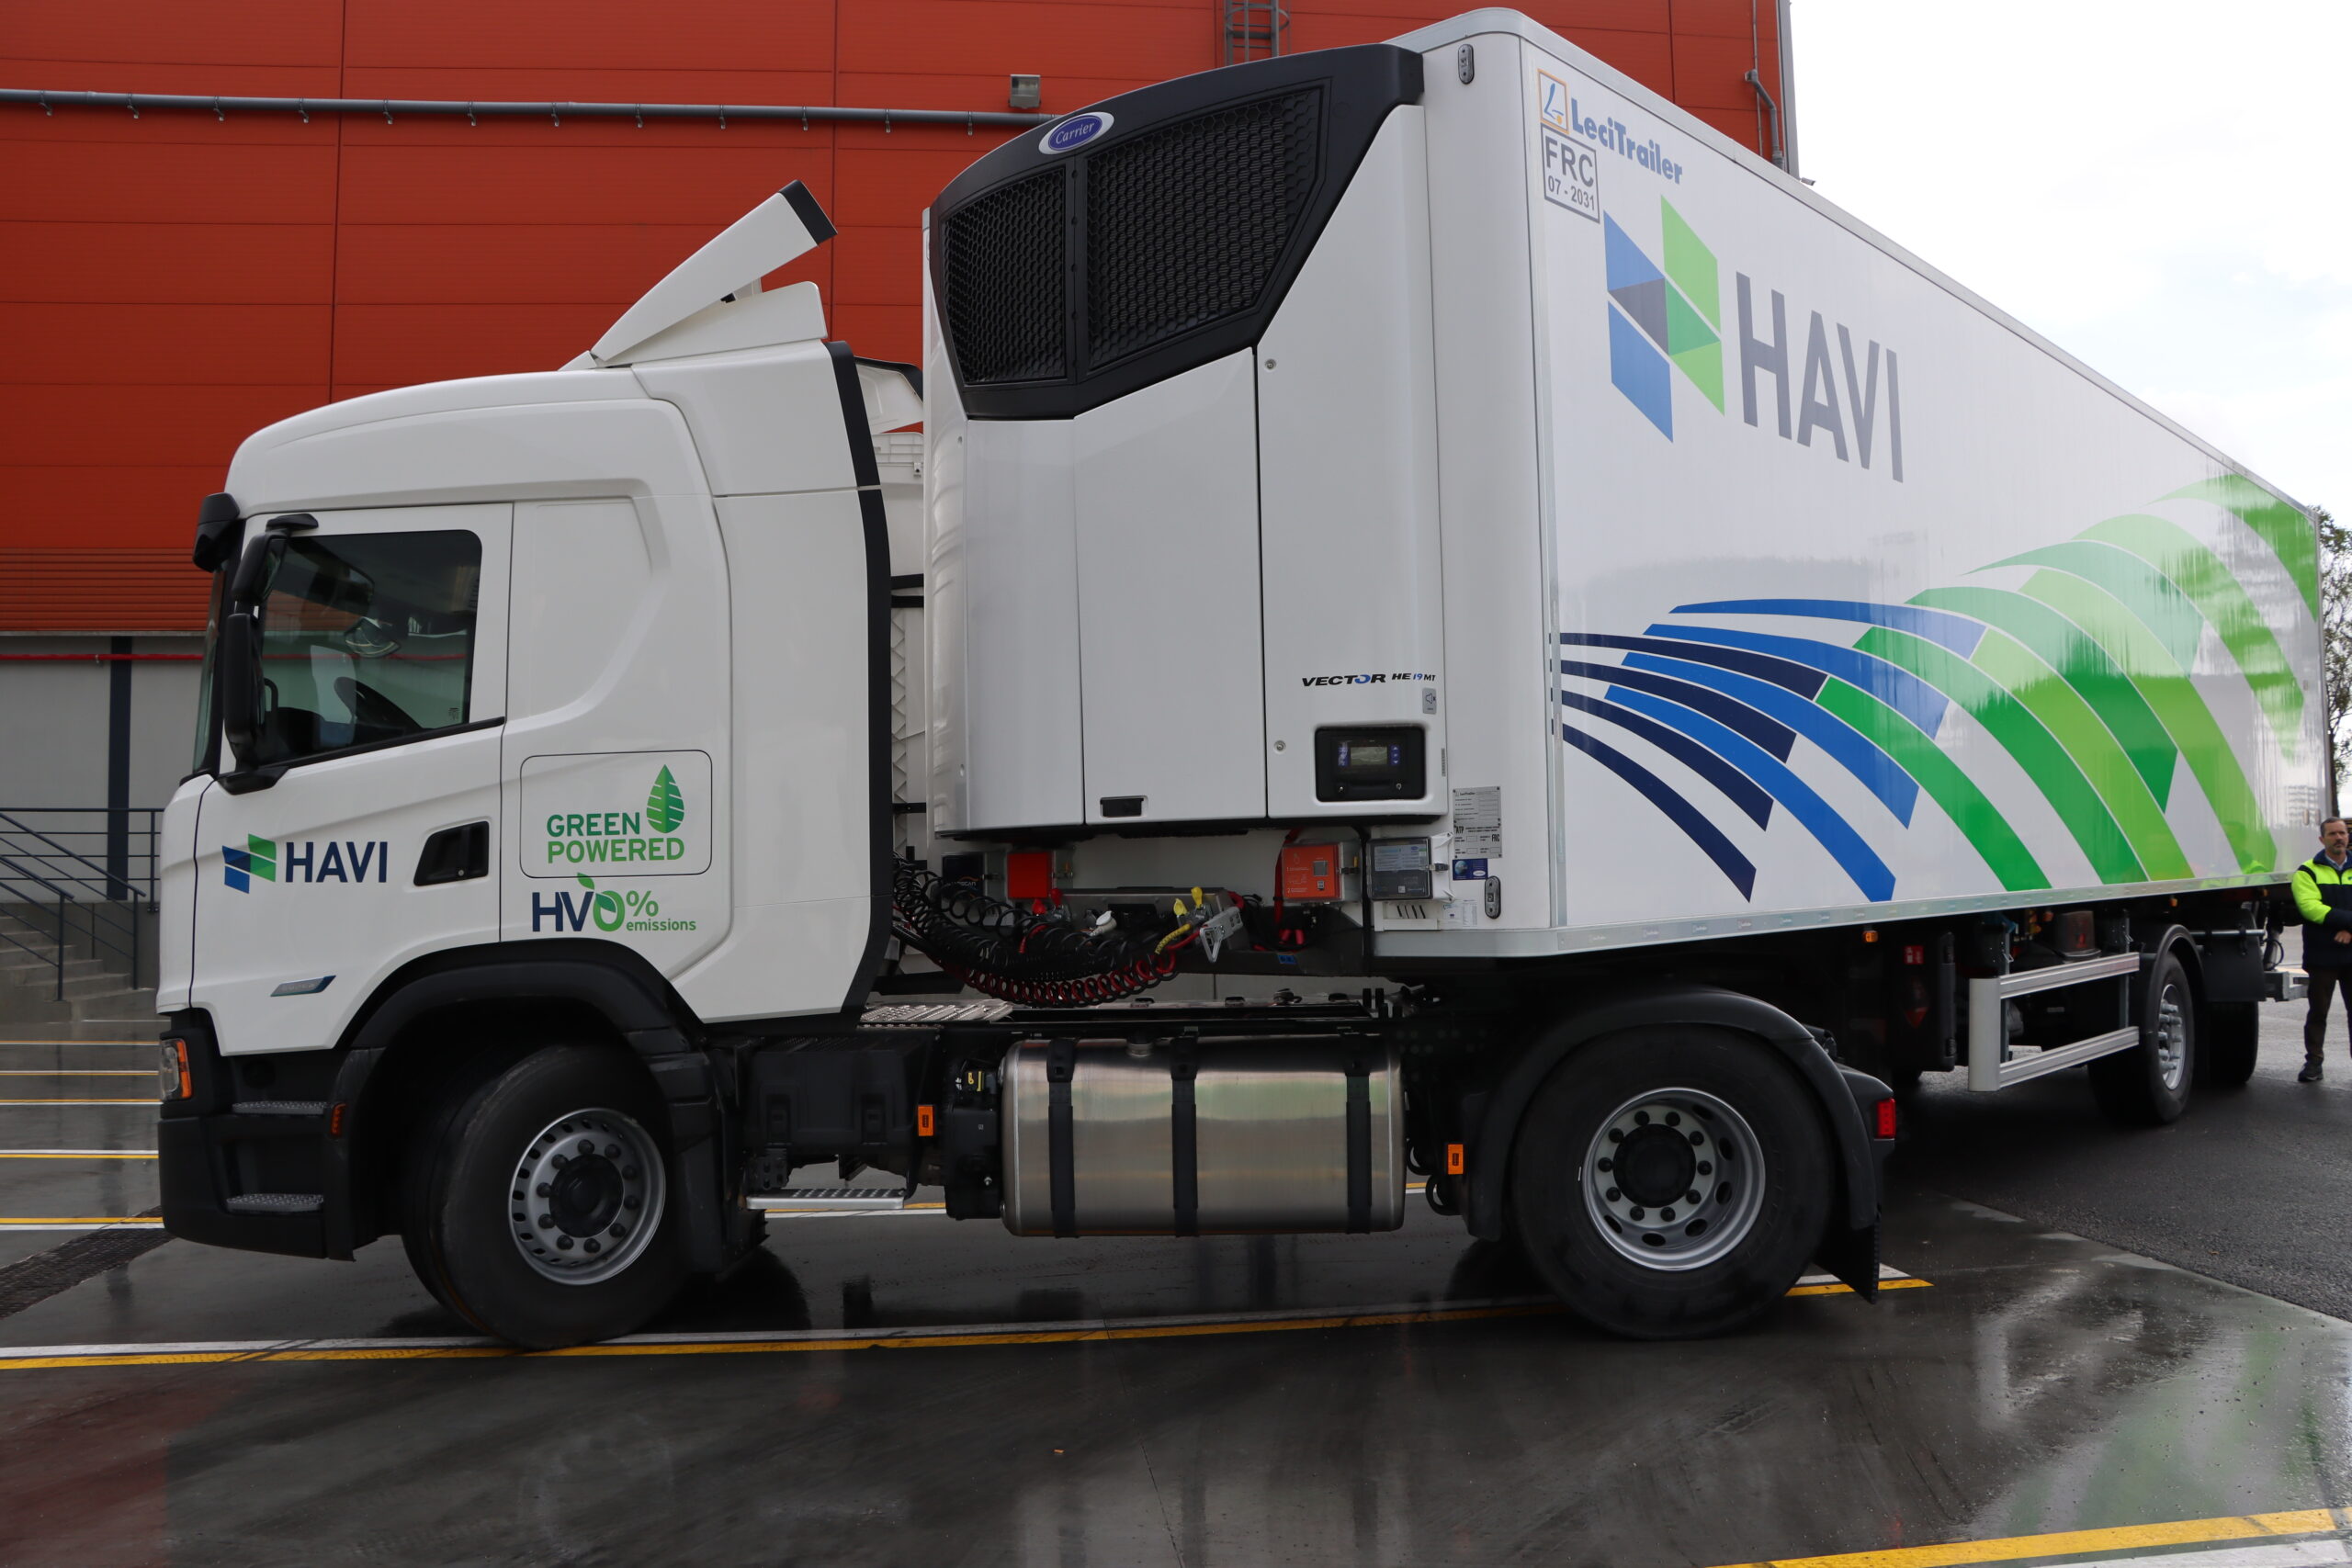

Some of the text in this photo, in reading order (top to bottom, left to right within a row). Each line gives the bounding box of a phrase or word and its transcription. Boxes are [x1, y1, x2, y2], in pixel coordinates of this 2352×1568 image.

[1056, 122, 1095, 144] Carrier
[1570, 97, 1683, 185] LeciTrailer
[1545, 135, 1594, 187] FRC
[1548, 175, 1561, 196] 07
[1570, 186, 1595, 211] 2031
[1736, 271, 1904, 483] HAVI
[1302, 673, 1386, 687] VECTOR
[547, 812, 640, 838] GREEN
[285, 841, 388, 884] HAVI
[548, 837, 684, 864] POWERED
[626, 918, 696, 931] emissions
